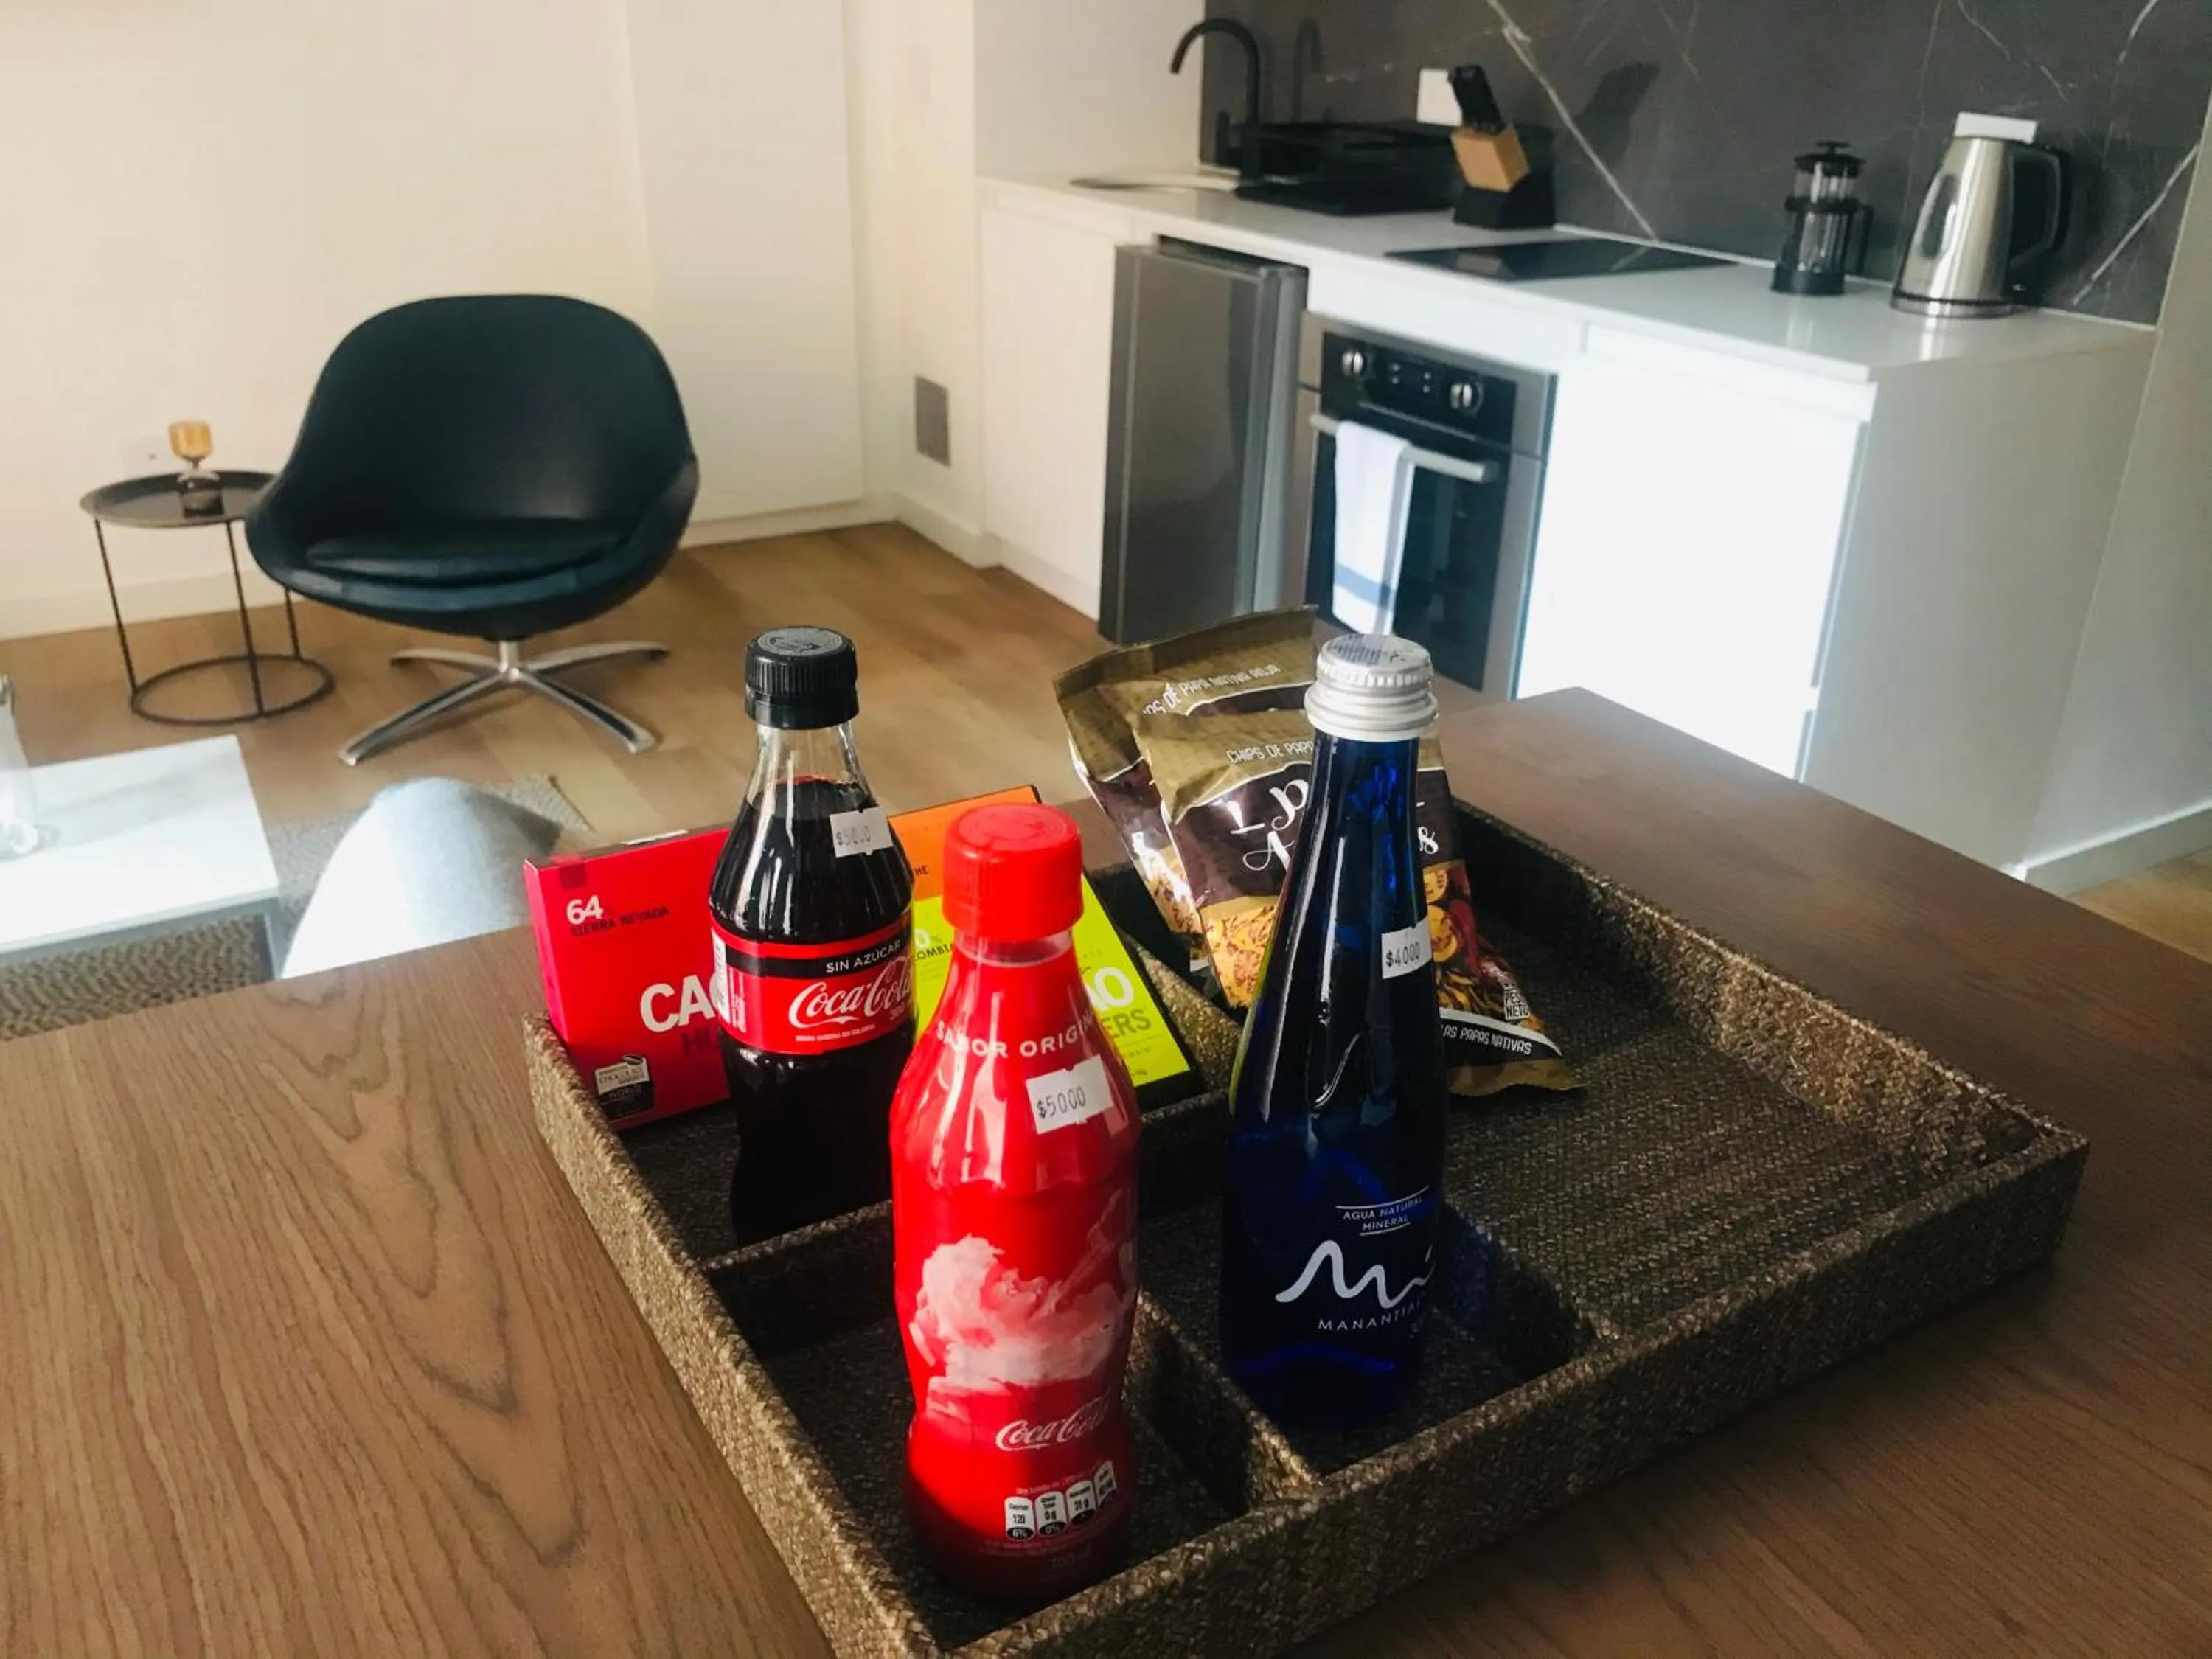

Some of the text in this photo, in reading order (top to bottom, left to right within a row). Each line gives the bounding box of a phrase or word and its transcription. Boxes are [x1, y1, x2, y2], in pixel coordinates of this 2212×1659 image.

[1226, 746, 1265, 764] CHIPS
[1265, 743, 1284, 757] DE
[566, 894, 604, 925] 64
[826, 939, 900, 973] SIN AZÚCAR
[1385, 941, 1421, 967] $4000
[937, 1020, 1009, 1059] SABOR
[1459, 1027, 1490, 1045] PAPAS
[1492, 1034, 1533, 1055] NATIVAS
[1036, 1085, 1087, 1119] $5000
[1342, 1210, 1376, 1221] AGUA
[1362, 1214, 1408, 1231] MINERAL
